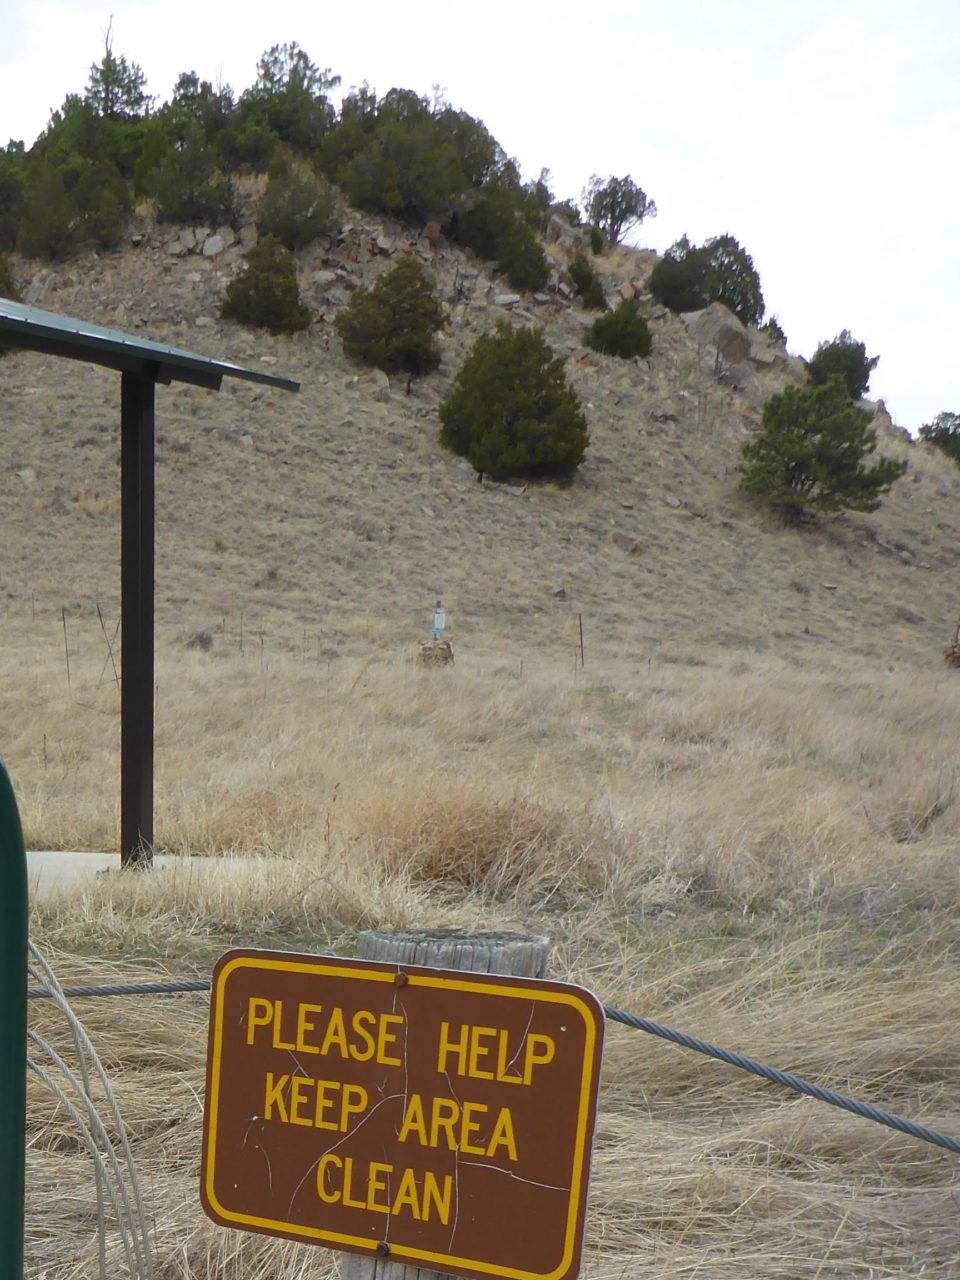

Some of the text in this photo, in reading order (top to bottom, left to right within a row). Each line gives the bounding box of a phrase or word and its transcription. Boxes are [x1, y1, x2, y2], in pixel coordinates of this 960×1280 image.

[246, 997, 555, 1086] PLEASE HELP
[263, 1071, 518, 1161] KEEP AREA
[316, 1154, 452, 1225] CLEAN
